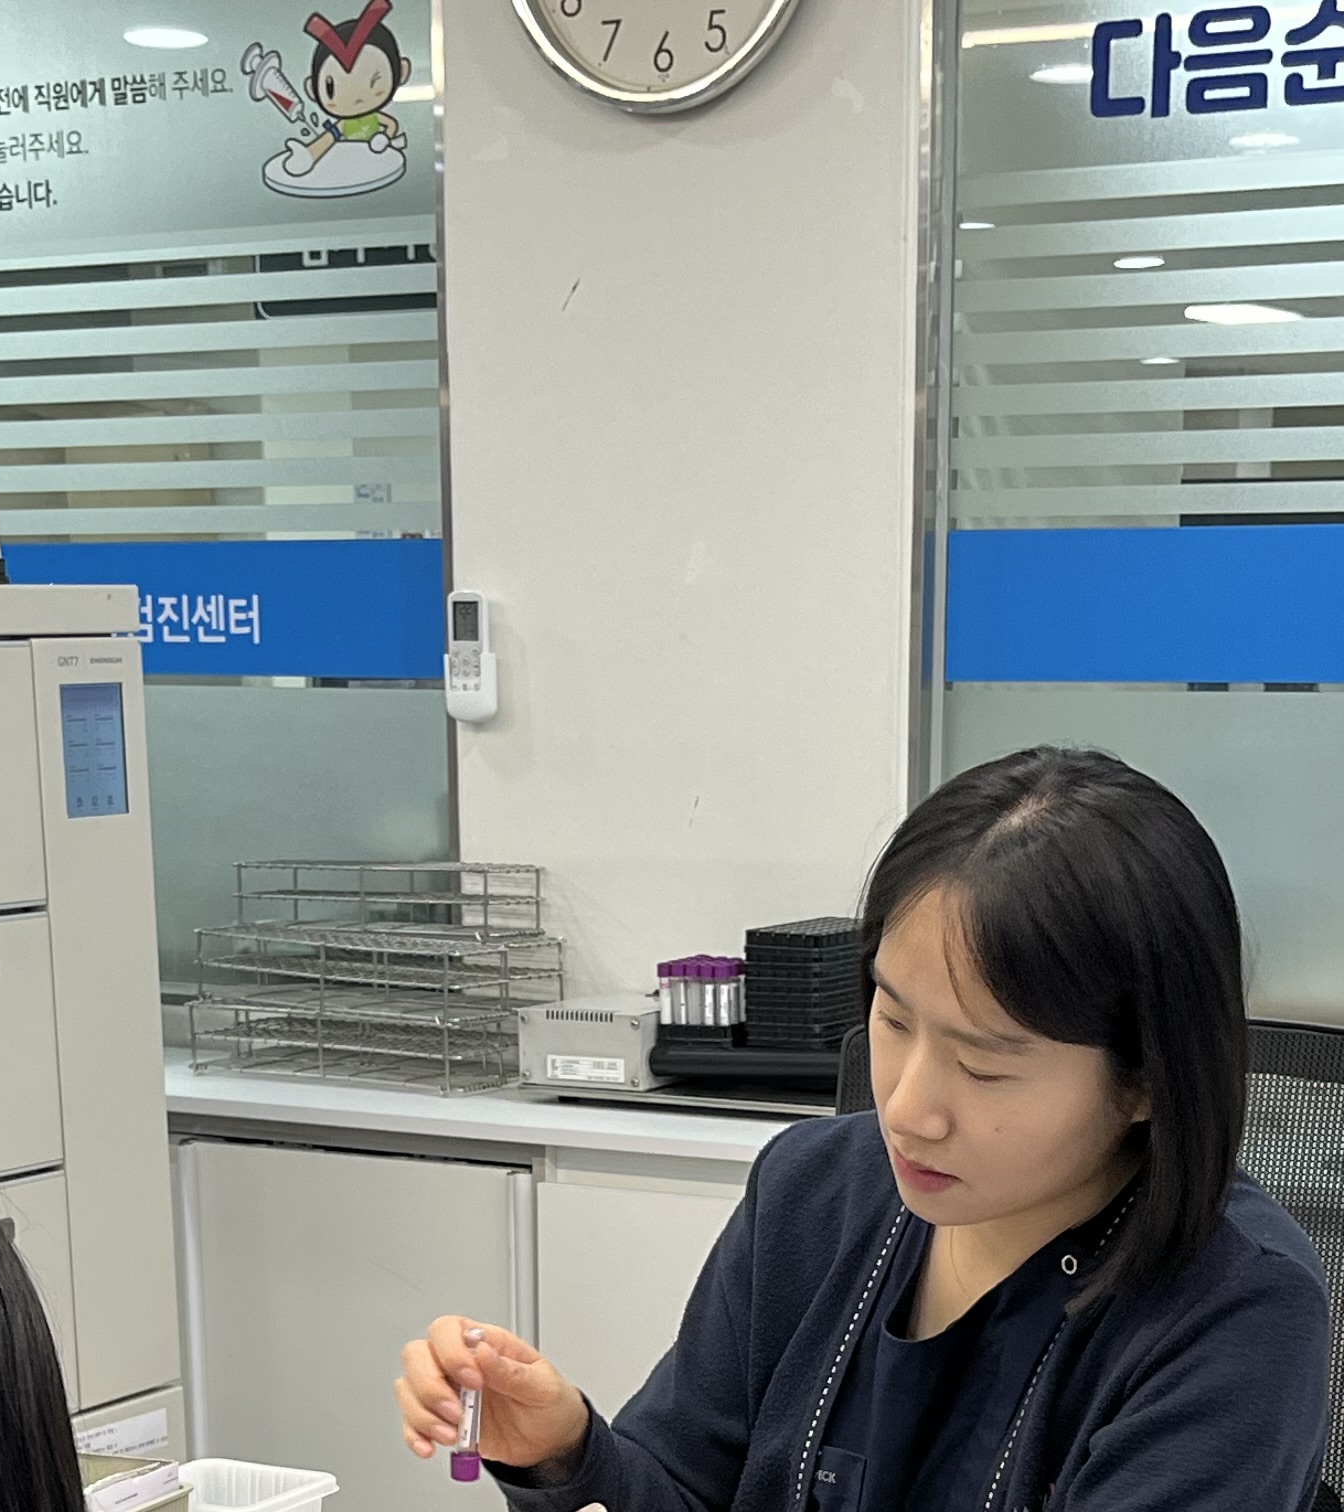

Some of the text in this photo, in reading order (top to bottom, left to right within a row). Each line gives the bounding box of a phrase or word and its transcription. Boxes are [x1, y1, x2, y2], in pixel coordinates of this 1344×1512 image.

[601, 10, 727, 73] 7 6 5
[34, 77, 107, 112] 직원에게
[110, 72, 167, 107] 말씀해
[171, 67, 234, 101] 주세요.
